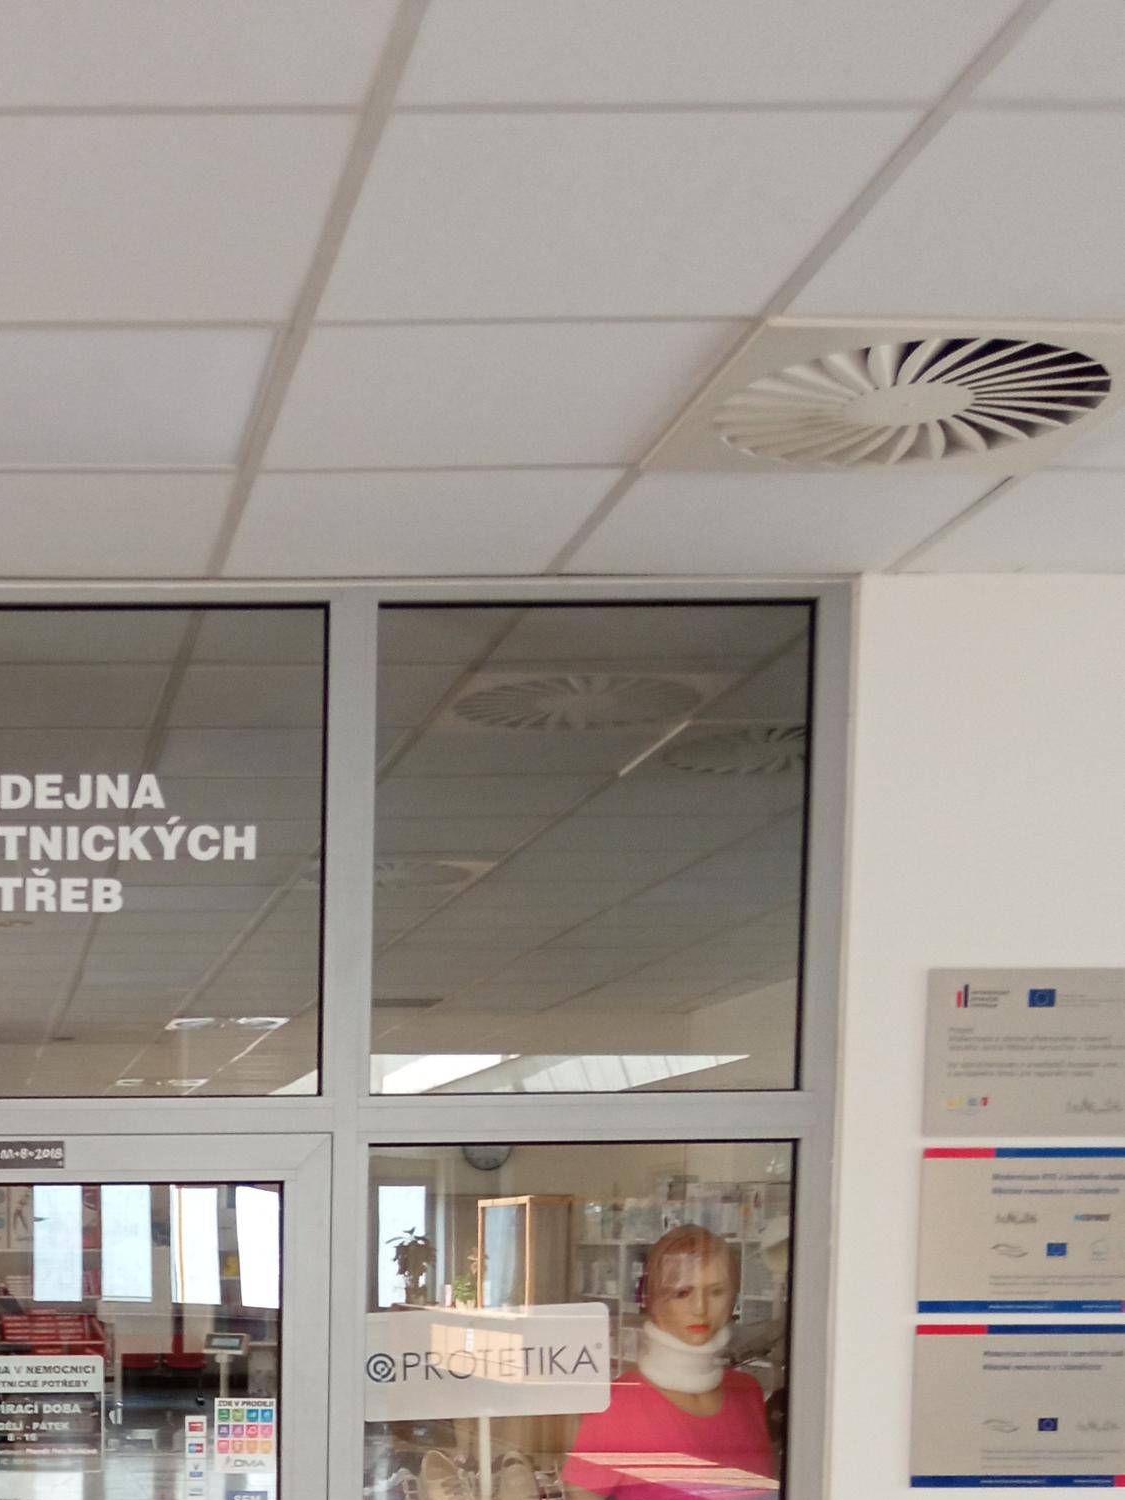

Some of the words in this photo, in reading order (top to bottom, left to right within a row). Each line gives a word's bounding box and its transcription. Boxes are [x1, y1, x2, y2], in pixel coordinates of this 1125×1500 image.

[15, 1365, 23, 1375] V
[26, 1364, 96, 1375] NEMOCNICI
[43, 1403, 82, 1415] DOBA
